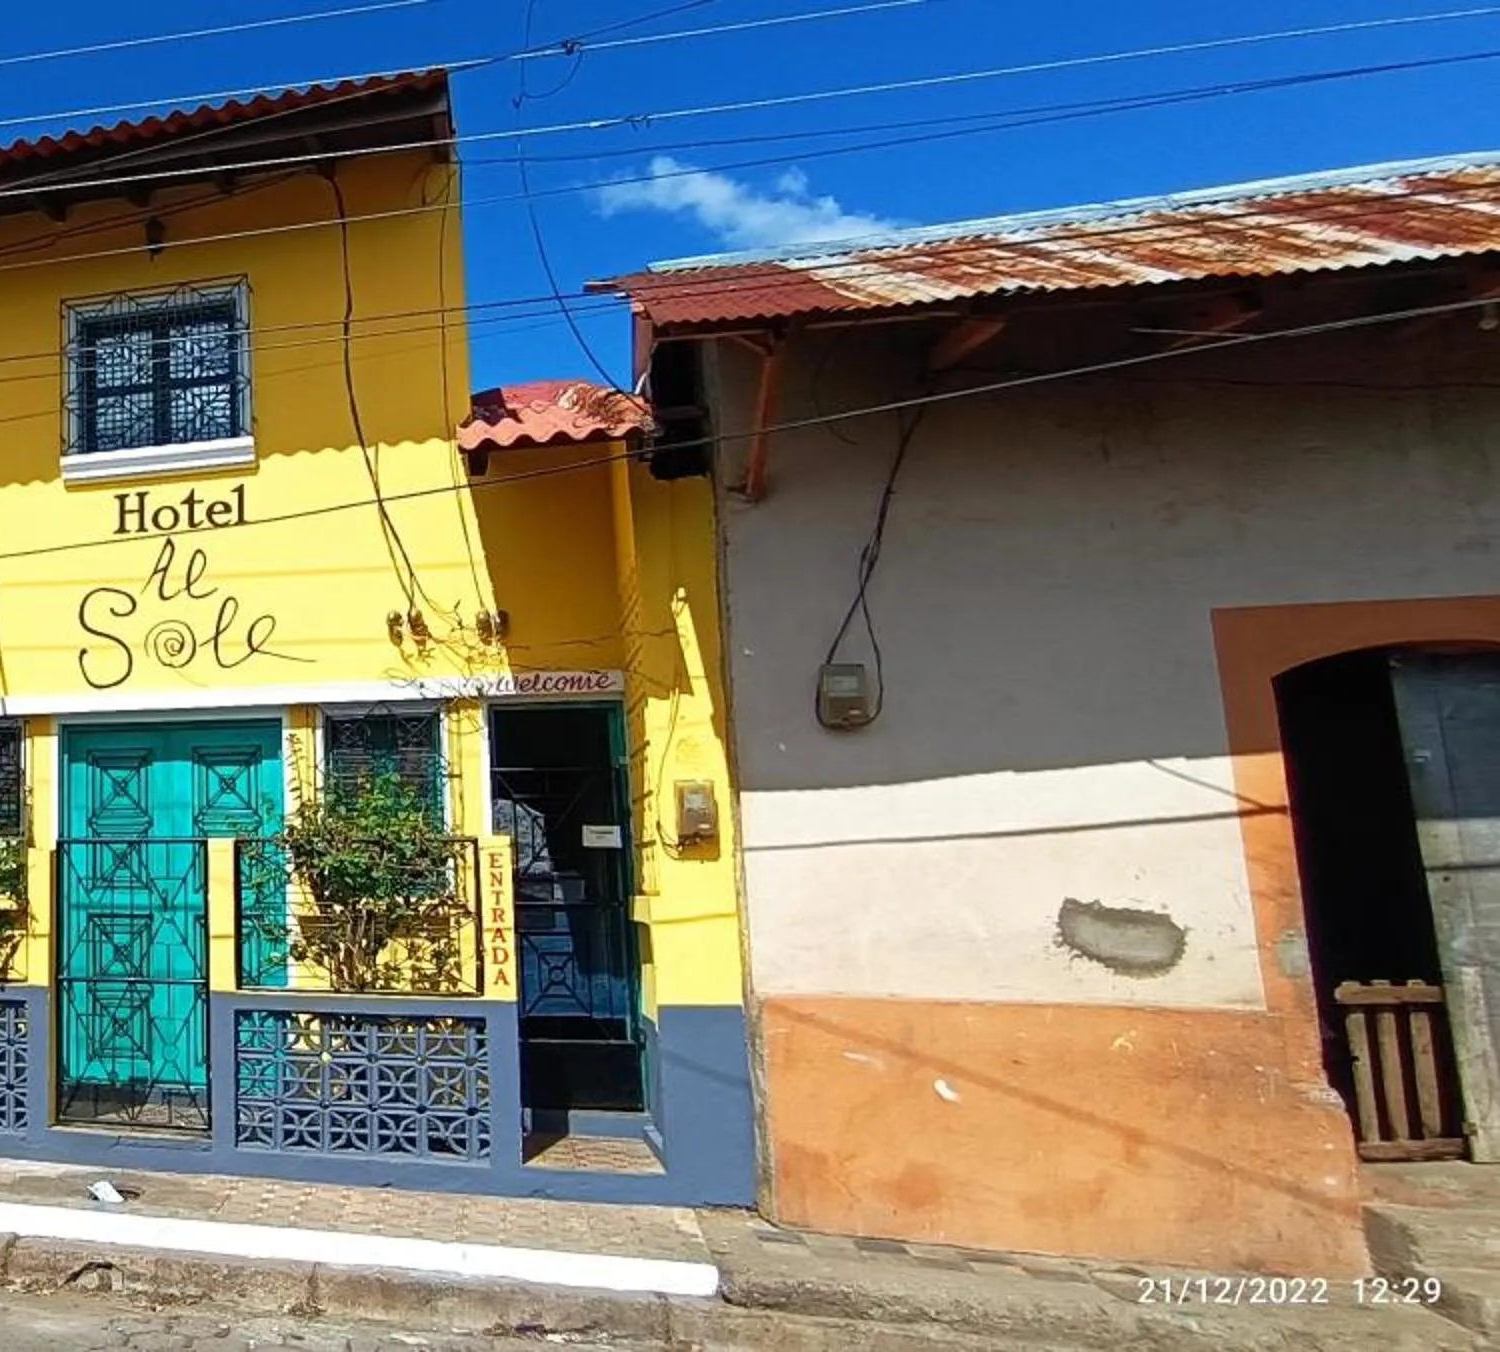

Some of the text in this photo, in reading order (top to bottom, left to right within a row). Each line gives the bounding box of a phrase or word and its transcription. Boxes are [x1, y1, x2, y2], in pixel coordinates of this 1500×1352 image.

[113, 484, 250, 534] Hotel
[141, 537, 218, 600] Al
[78, 587, 317, 688] Sole
[488, 852, 510, 986] ENTRADA
